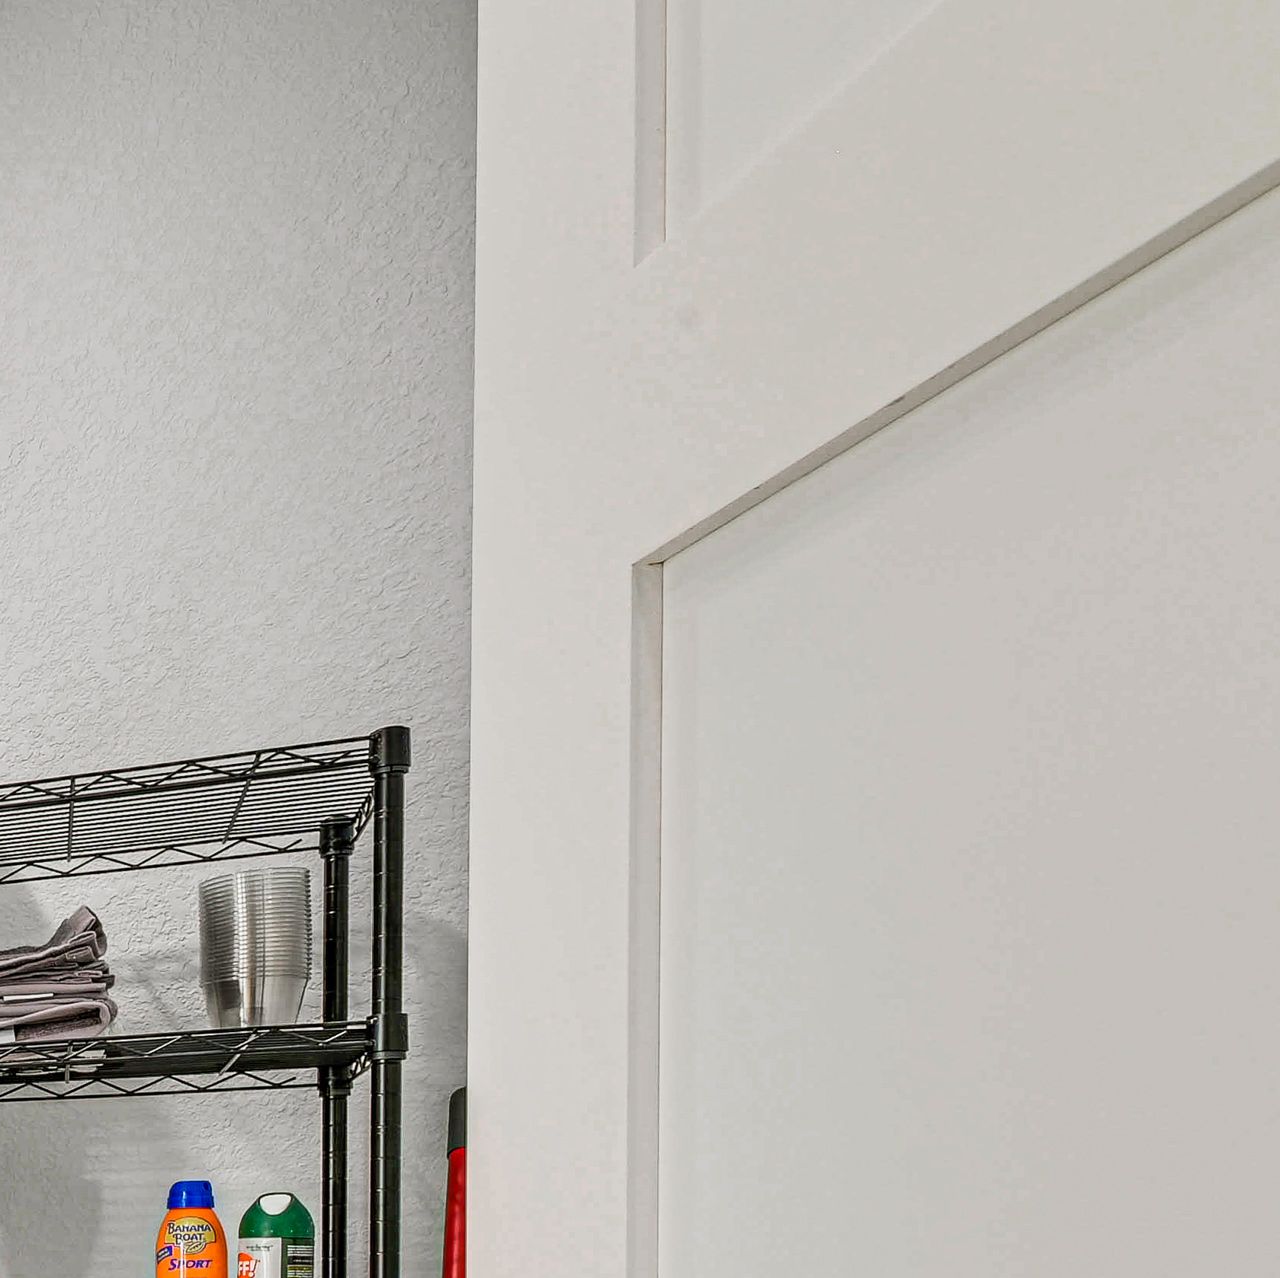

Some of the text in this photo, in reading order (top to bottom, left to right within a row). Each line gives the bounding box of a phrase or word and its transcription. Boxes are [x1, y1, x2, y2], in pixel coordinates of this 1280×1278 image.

[168, 1222, 211, 1234] BANANA
[173, 1233, 205, 1245] BOAT
[168, 1259, 213, 1271] SPORT
[238, 1260, 258, 1278] FF!
